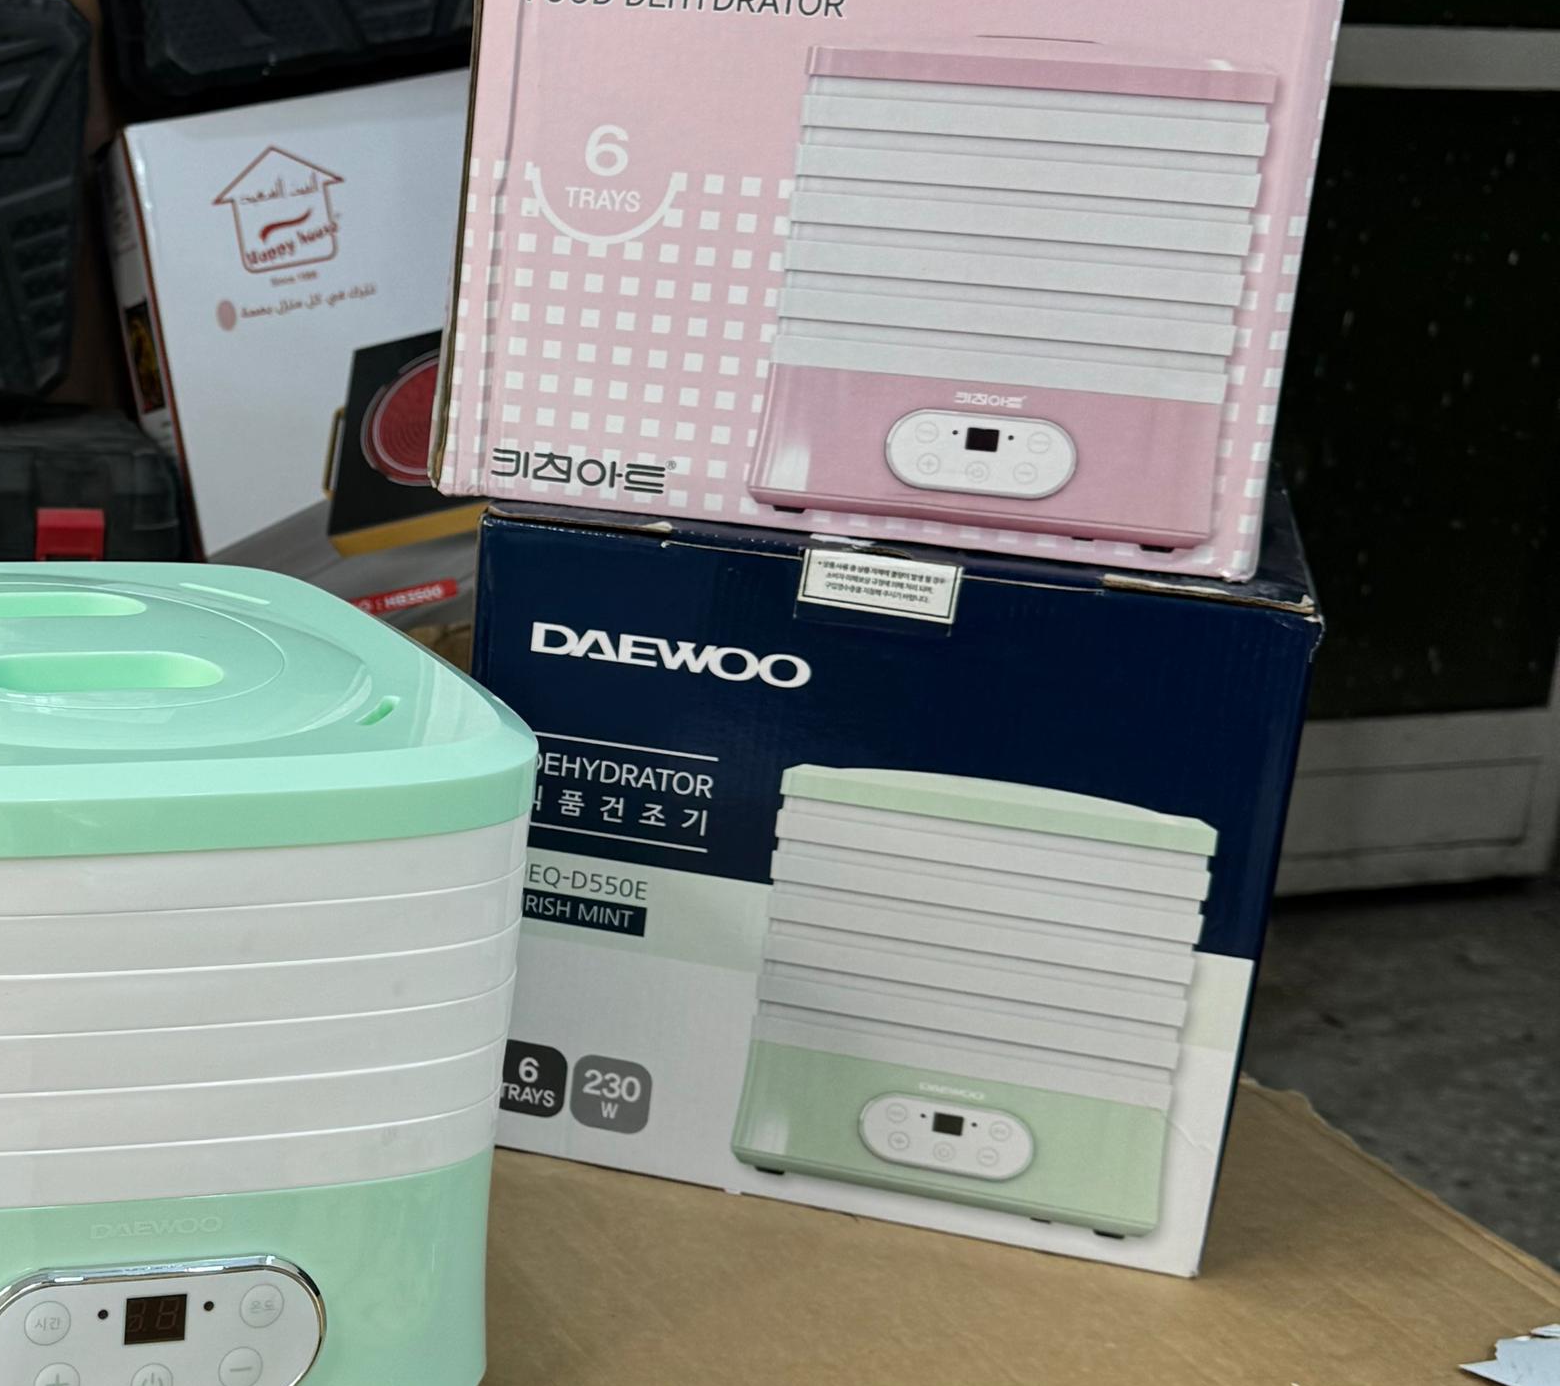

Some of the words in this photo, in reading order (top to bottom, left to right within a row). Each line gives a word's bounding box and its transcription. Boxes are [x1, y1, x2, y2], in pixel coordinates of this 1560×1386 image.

[584, 124, 629, 178] 6
[565, 184, 642, 214] TRAYS
[530, 620, 812, 690] DAEWOO
[577, 902, 635, 929] MINT
[517, 1056, 540, 1084] 6
[581, 1068, 642, 1103] 230
[918, 1081, 987, 1102] DAEWOO
[600, 1100, 620, 1120] W
[89, 1216, 225, 1240] DAEWOO
